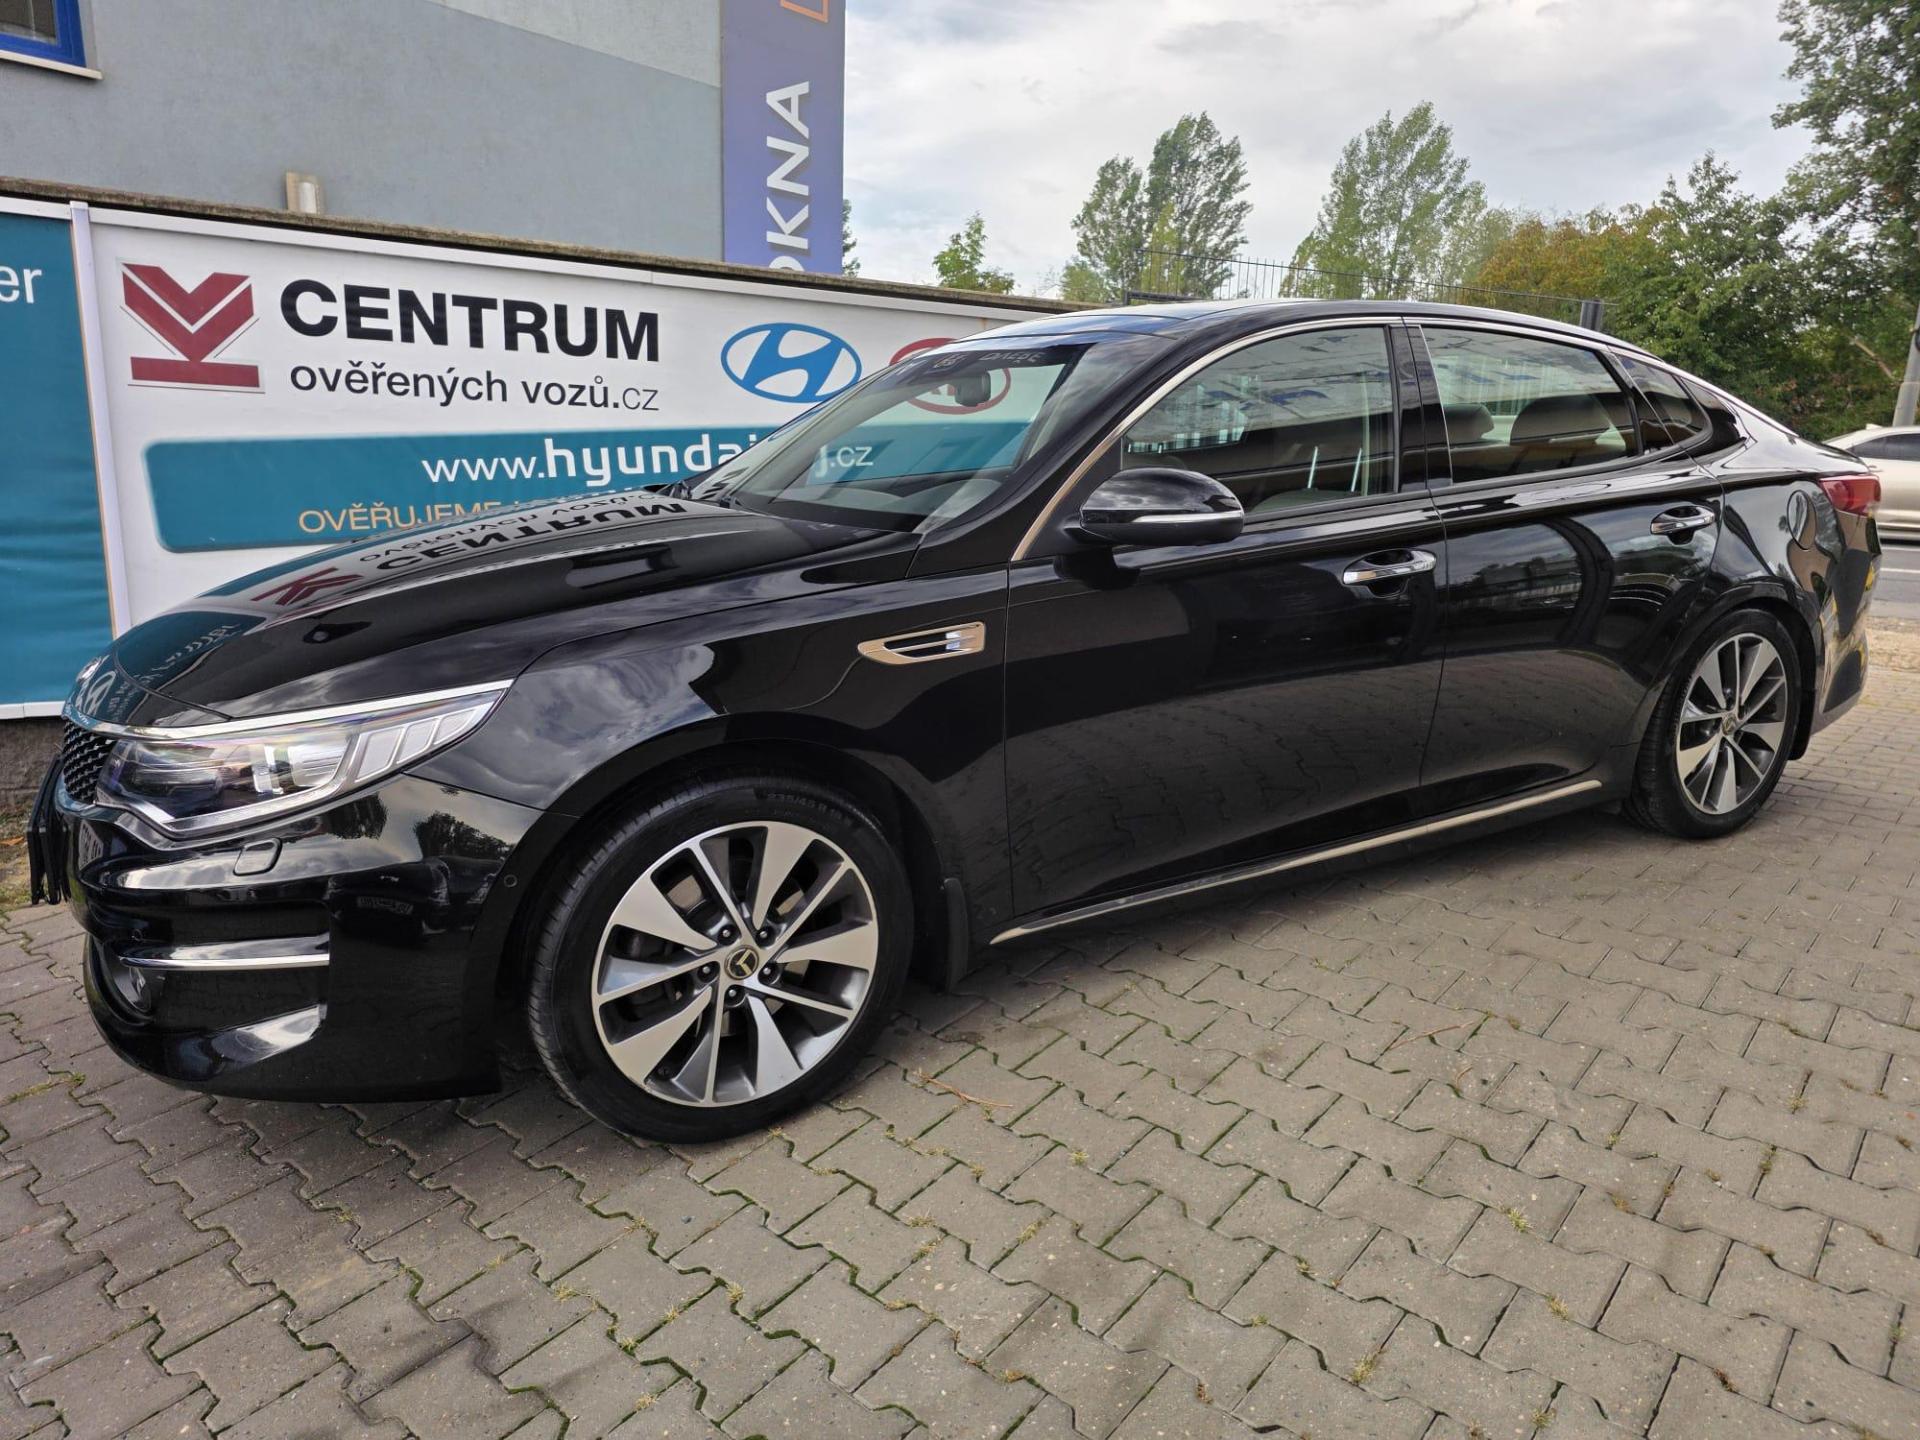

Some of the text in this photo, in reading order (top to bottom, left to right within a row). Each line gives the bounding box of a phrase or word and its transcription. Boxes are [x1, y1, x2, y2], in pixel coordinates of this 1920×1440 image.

[0, 265, 42, 304] er
[280, 279, 659, 362] CENTRUM
[290, 360, 660, 411] ověřených vozů.cz
